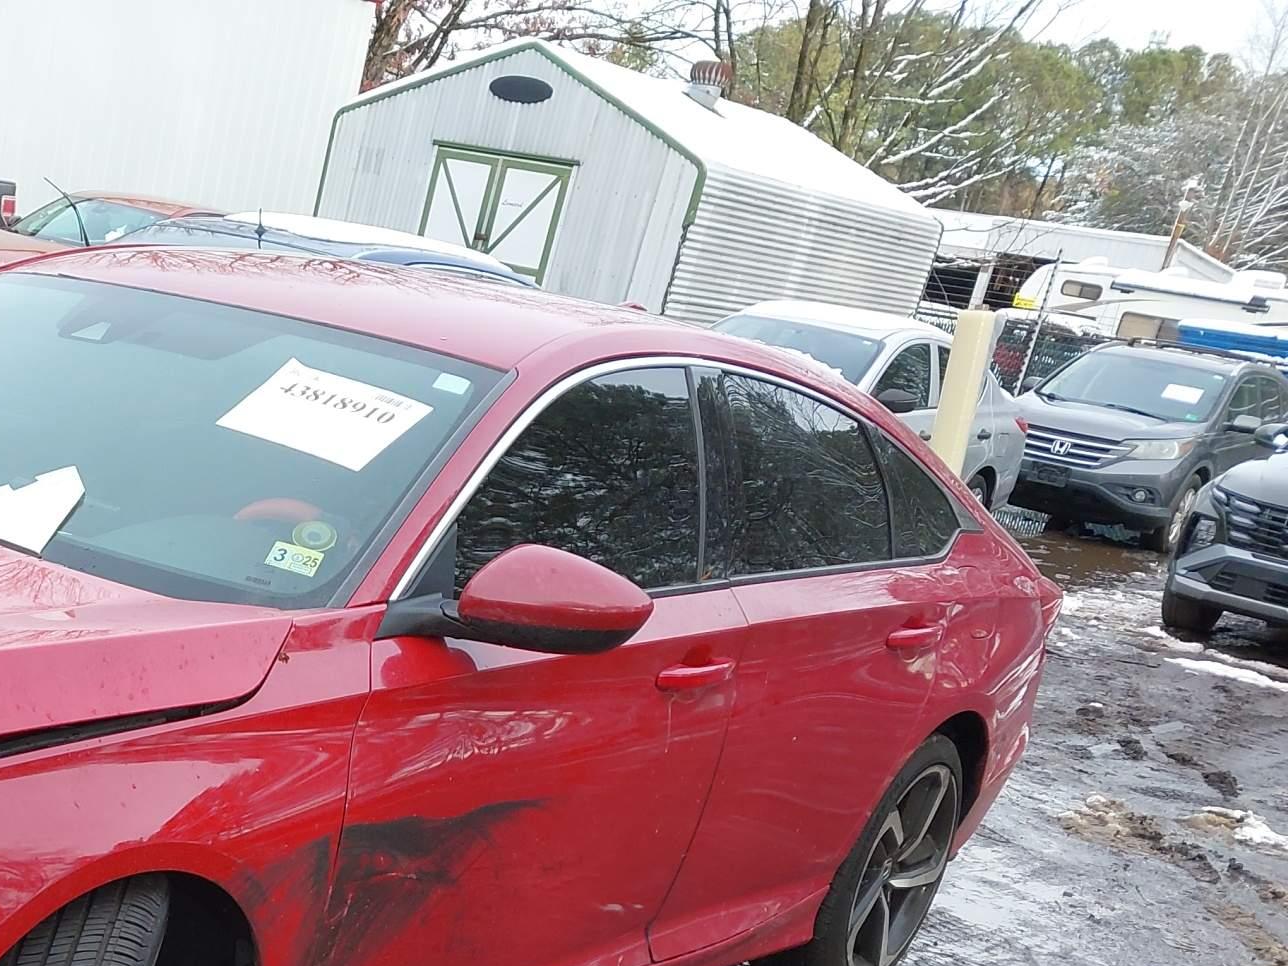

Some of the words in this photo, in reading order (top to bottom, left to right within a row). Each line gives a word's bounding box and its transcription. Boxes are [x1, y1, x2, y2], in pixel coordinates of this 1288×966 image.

[279, 382, 396, 424] 43818910
[273, 548, 288, 562] 3
[302, 556, 320, 568] 25
